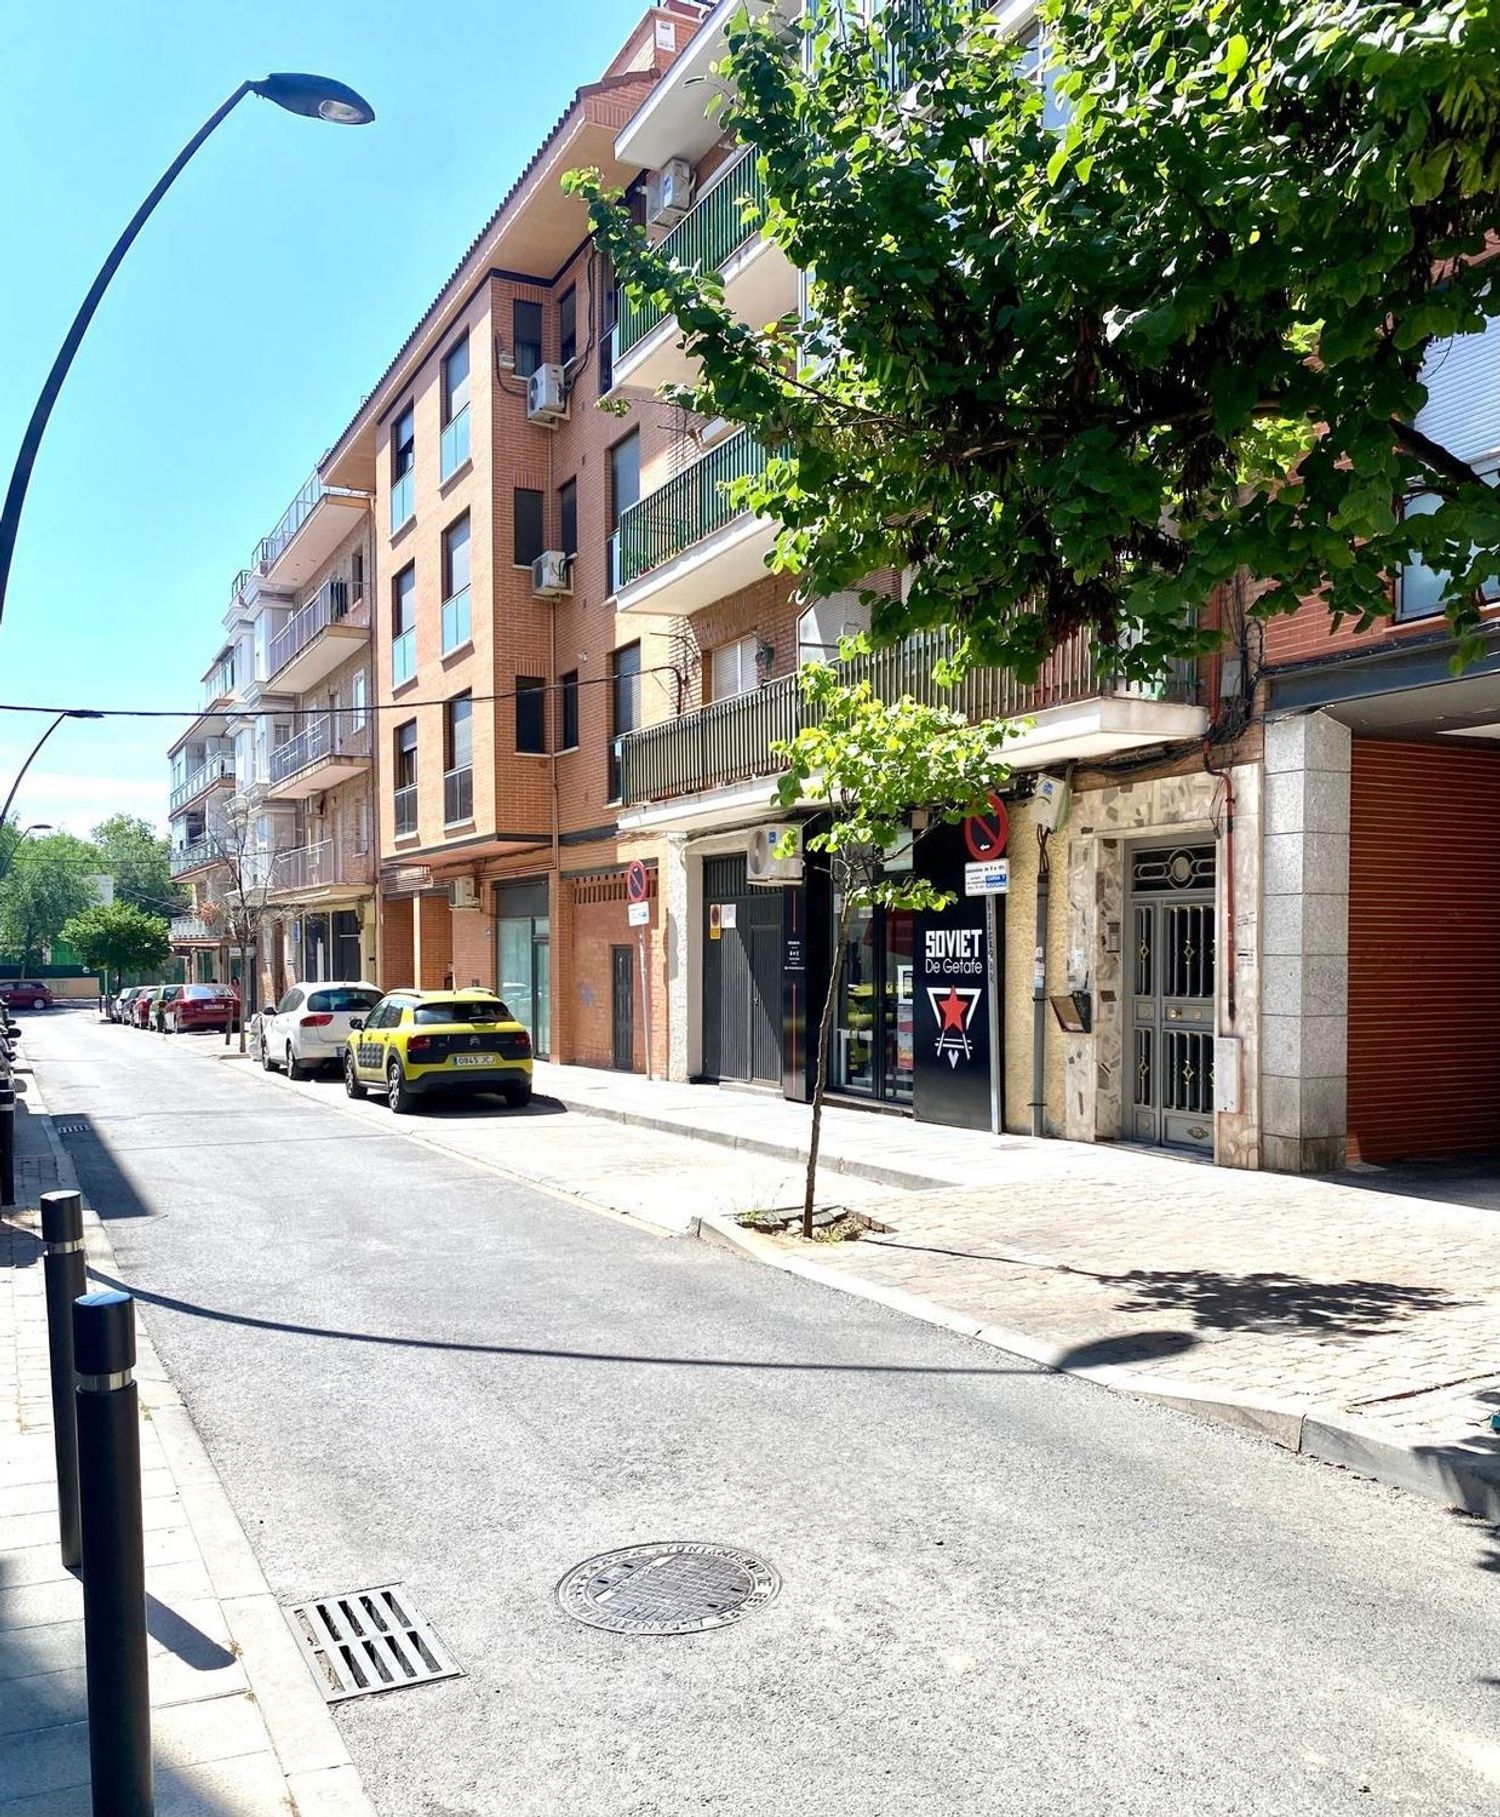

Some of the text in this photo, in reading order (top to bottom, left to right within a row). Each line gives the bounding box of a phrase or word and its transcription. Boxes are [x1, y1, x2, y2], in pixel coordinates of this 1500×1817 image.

[926, 929, 982, 957] SOVIET
[926, 958, 983, 974] De Getafe
